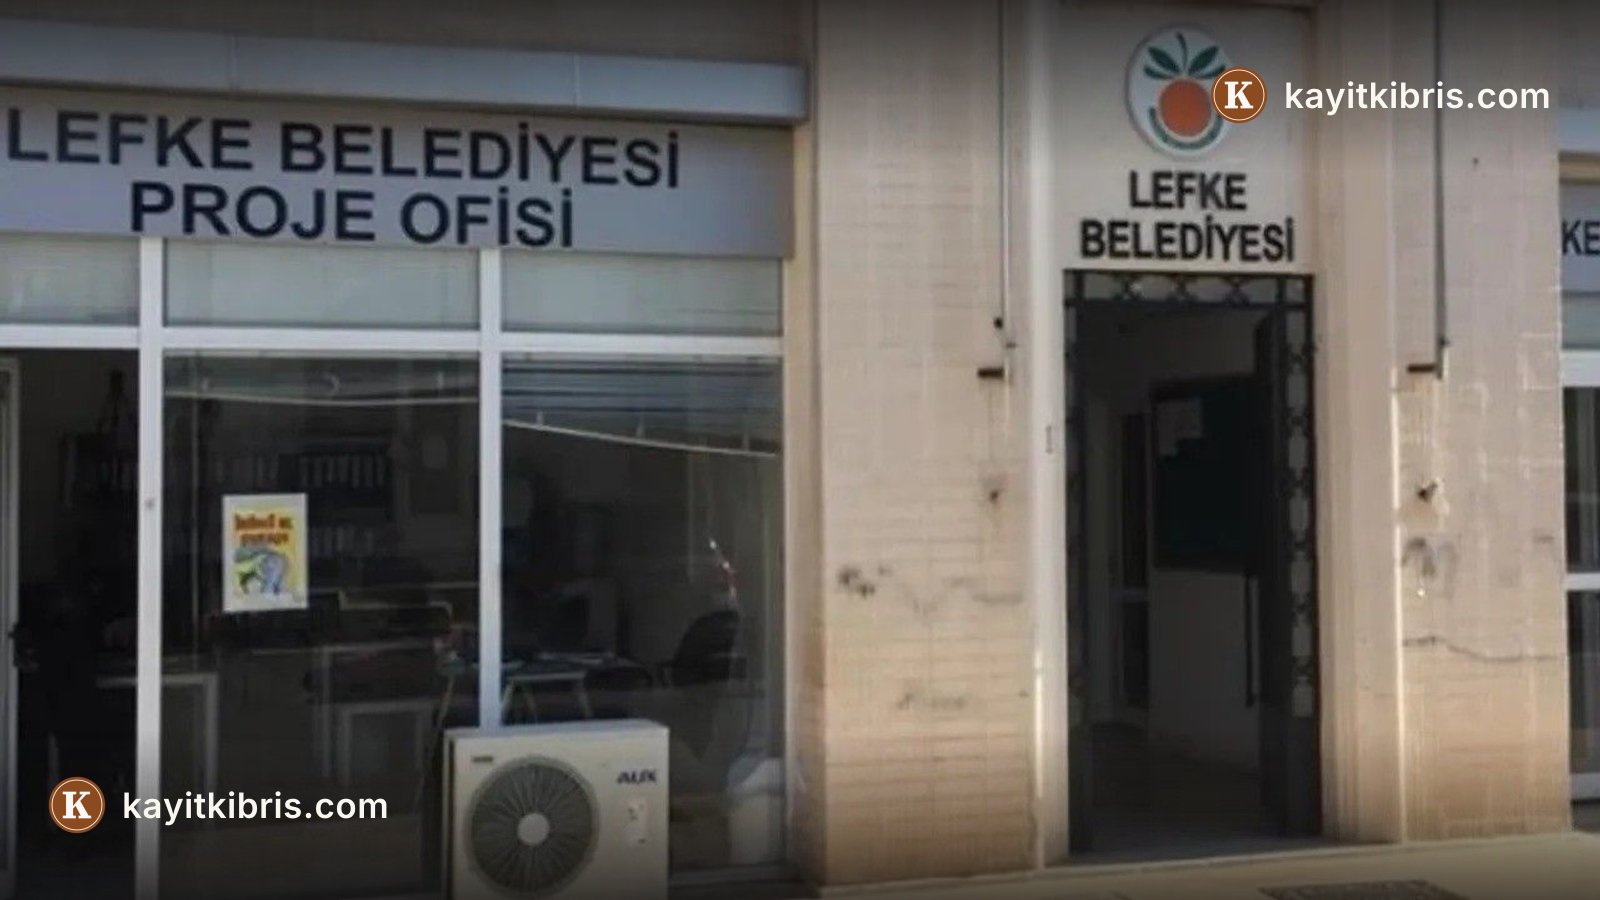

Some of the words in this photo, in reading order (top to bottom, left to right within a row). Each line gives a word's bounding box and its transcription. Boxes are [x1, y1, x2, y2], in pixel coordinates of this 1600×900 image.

[7, 108, 253, 170] LEFKE
[280, 121, 679, 188] BELEDİYESİ
[1129, 170, 1247, 210] LEFKE
[131, 181, 375, 241] PROJE
[400, 186, 573, 248] OFİSİ
[1080, 215, 1295, 262] BELEDİYESİ
[617, 769, 658, 785] AUX
